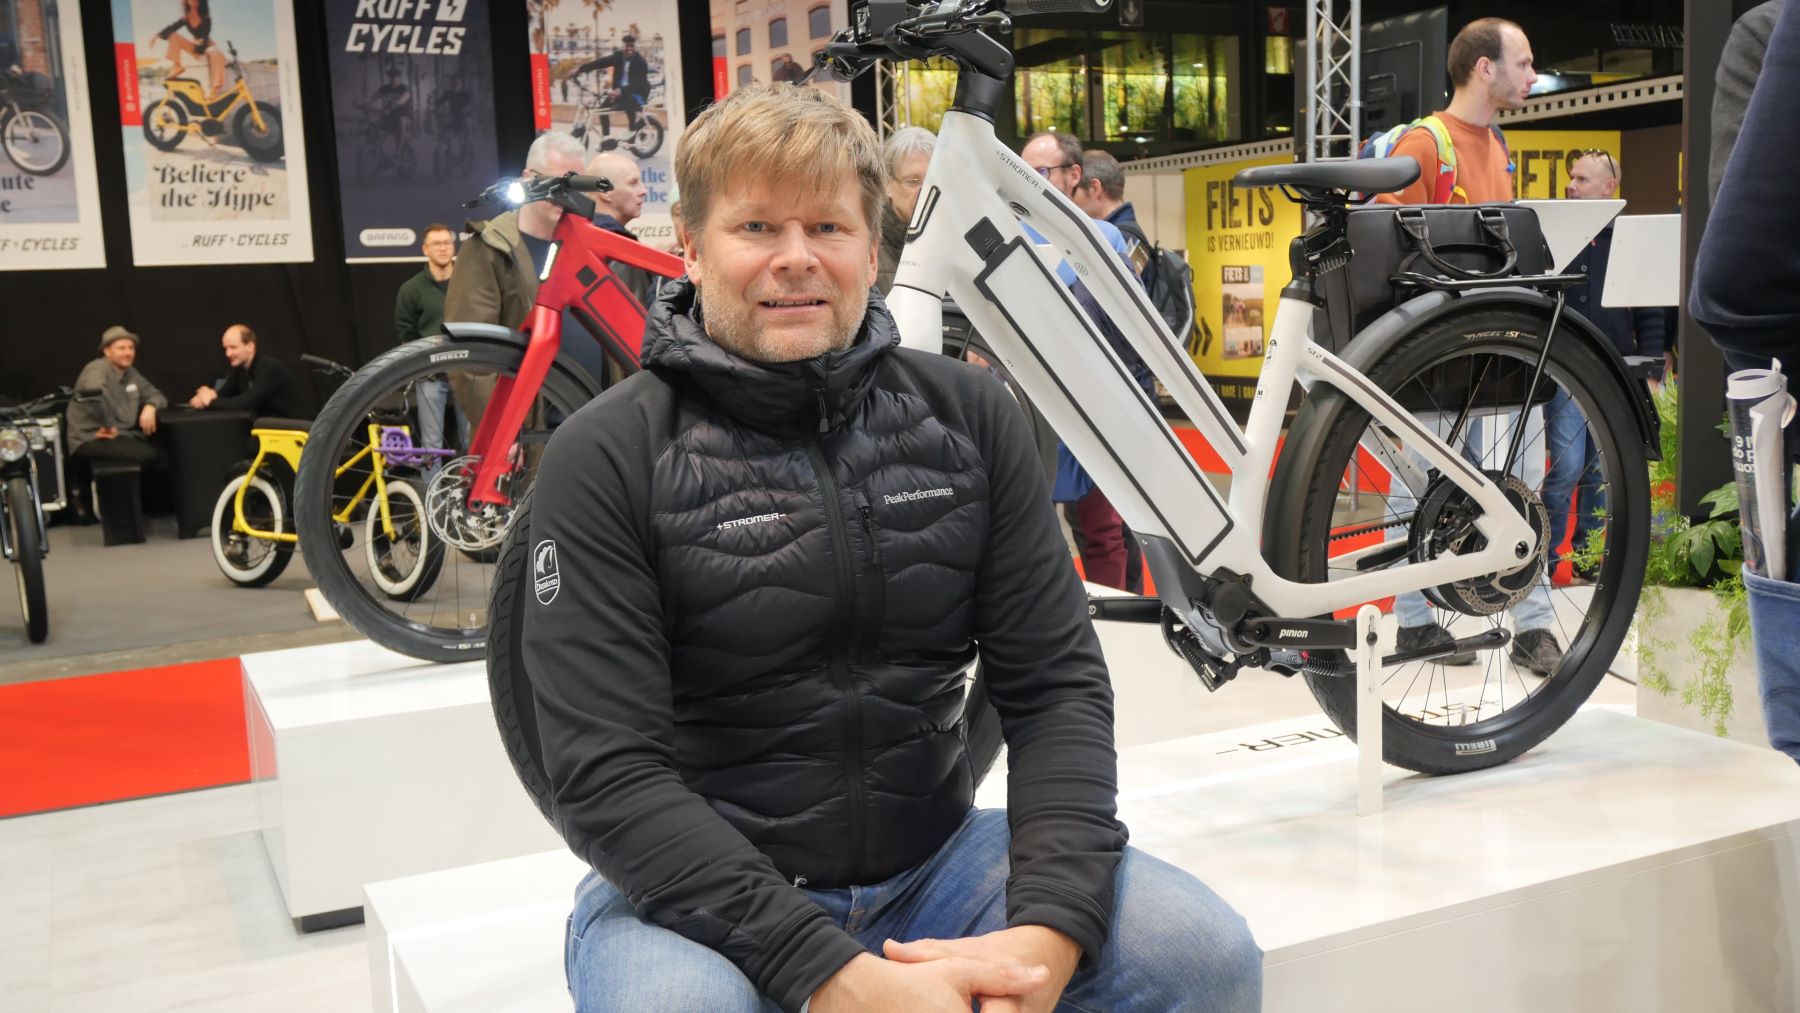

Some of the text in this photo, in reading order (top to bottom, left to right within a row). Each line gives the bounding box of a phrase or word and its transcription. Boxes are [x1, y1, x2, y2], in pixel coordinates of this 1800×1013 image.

[345, 23, 466, 55] CYCLES
[161, 185, 276, 212] the Hype
[1206, 178, 1275, 231] FIETS
[21, 237, 80, 252] CYCLES
[192, 234, 227, 247] RUFF
[237, 232, 291, 247] CYCLES
[1207, 231, 1275, 253] IS VERNIEUWD!
[1279, 628, 1309, 639] pinion
